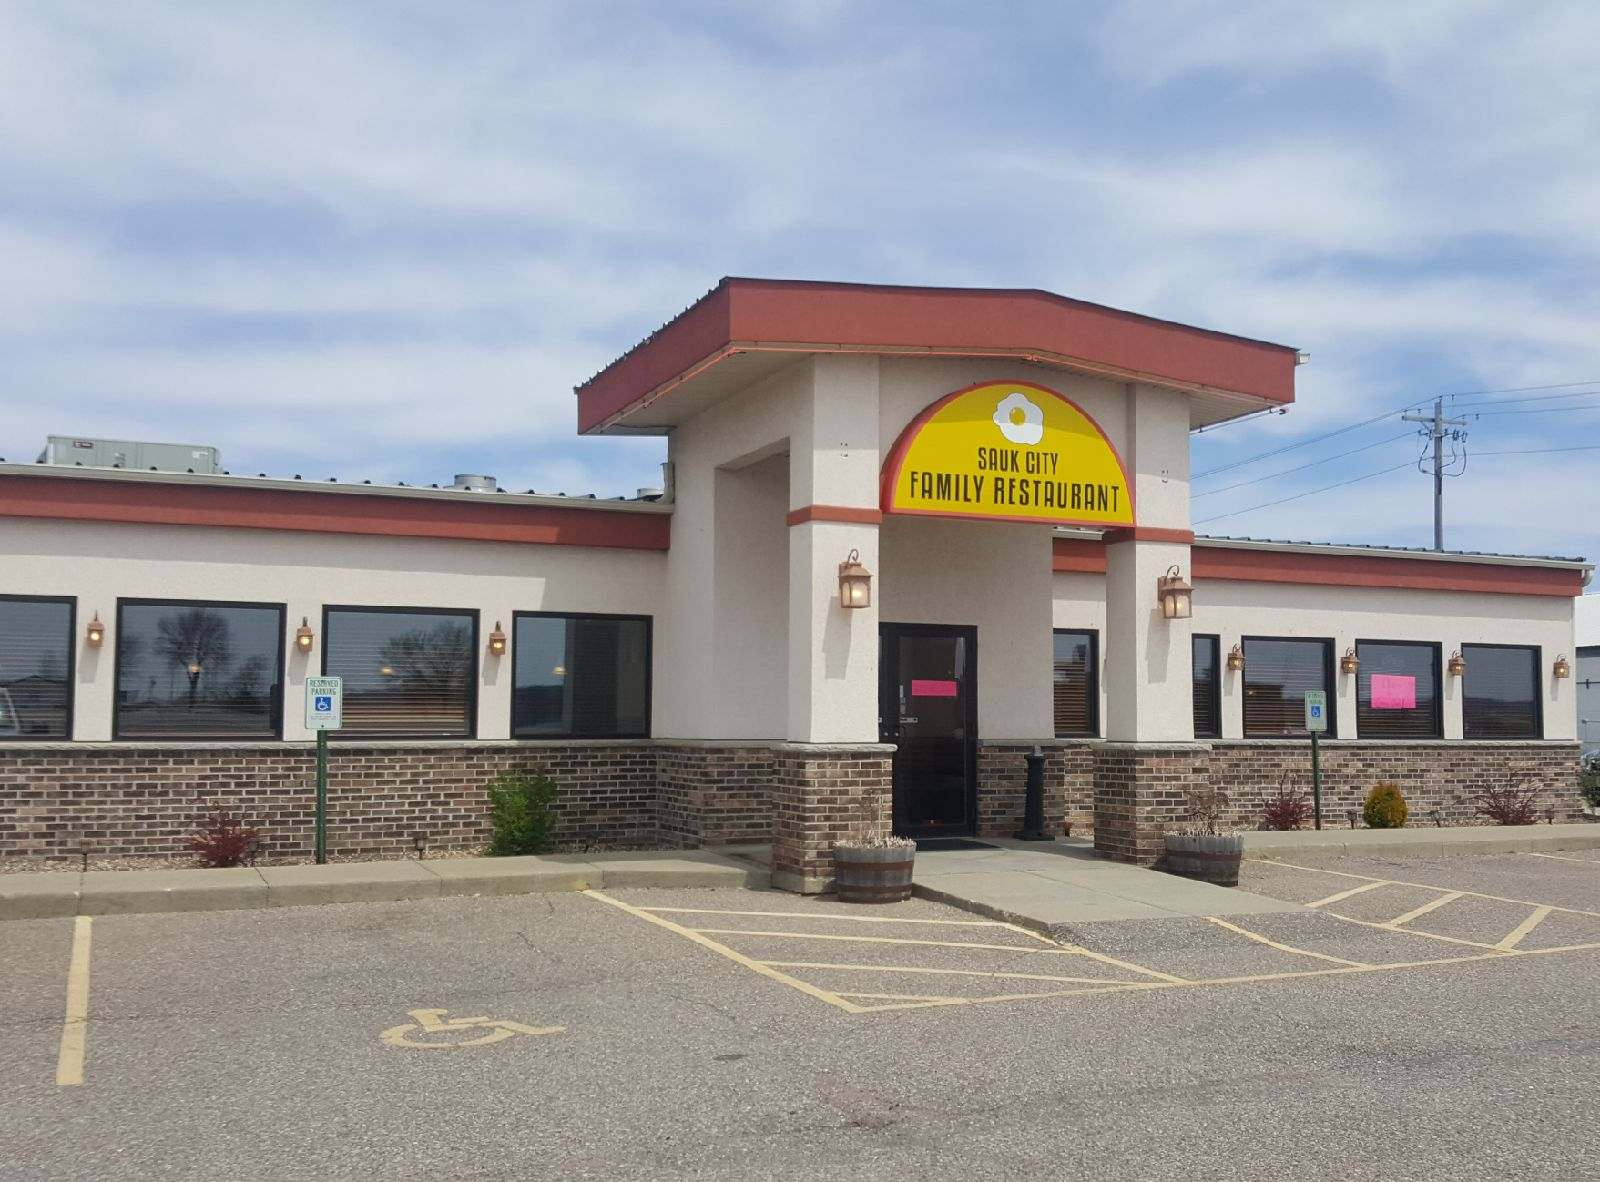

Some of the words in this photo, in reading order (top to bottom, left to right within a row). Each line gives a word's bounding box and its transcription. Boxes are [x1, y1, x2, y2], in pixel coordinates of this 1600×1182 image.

[978, 447, 1020, 474] SAUK
[1025, 451, 1059, 475] CITY
[910, 471, 985, 503] FAMILY
[994, 477, 1120, 512] RESTAURANT
[310, 679, 339, 688] RESERVED
[311, 687, 337, 696] PARKING
